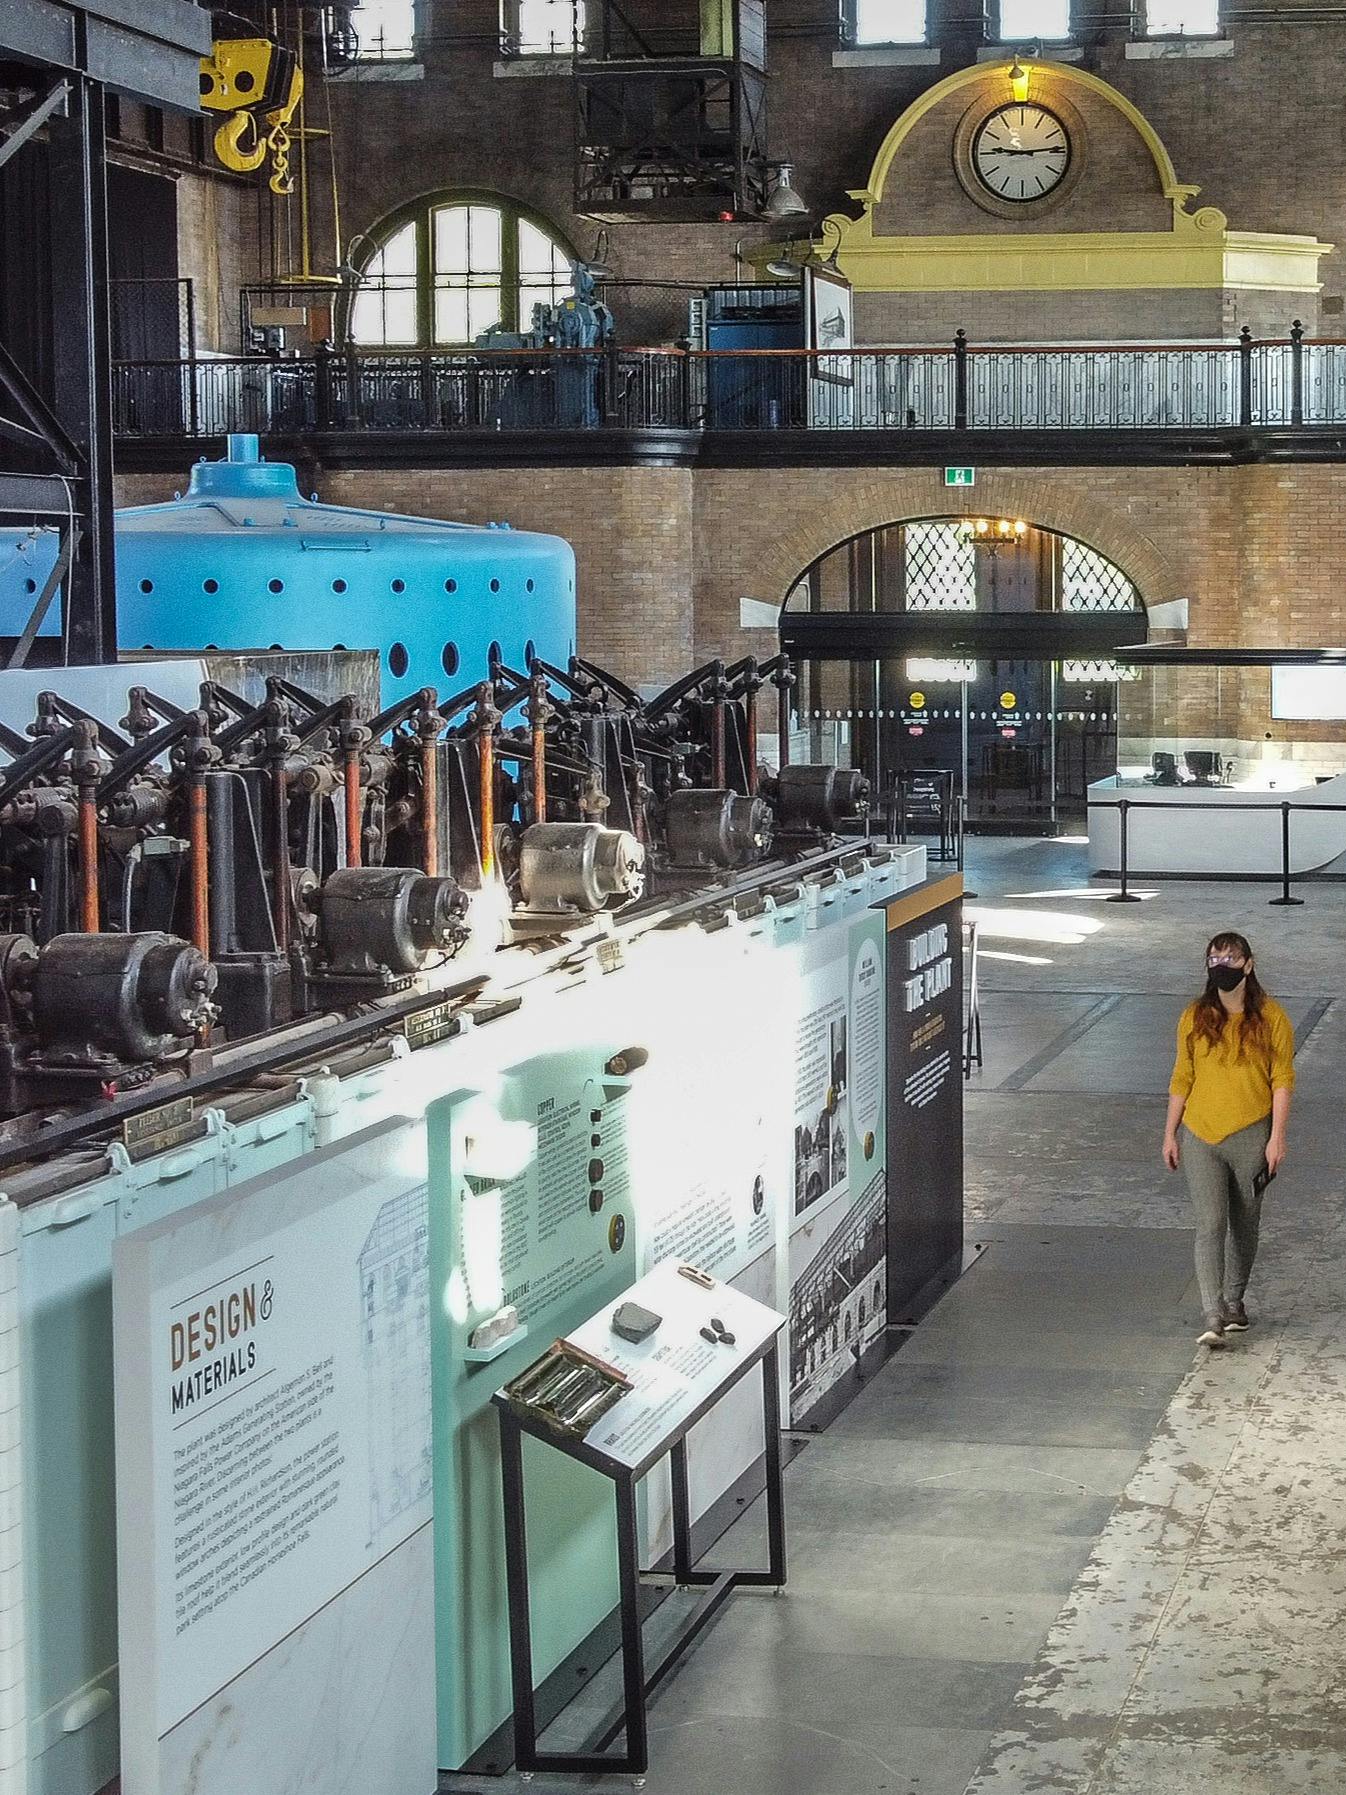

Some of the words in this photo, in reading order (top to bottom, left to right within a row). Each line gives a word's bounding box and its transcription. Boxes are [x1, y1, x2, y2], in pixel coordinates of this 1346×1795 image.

[904, 974, 924, 1012] THE
[924, 957, 952, 1001] PLANT
[171, 1283, 256, 1371] DESIGN
[260, 1279, 274, 1320] &
[171, 1342, 256, 1415] MATERIALS
